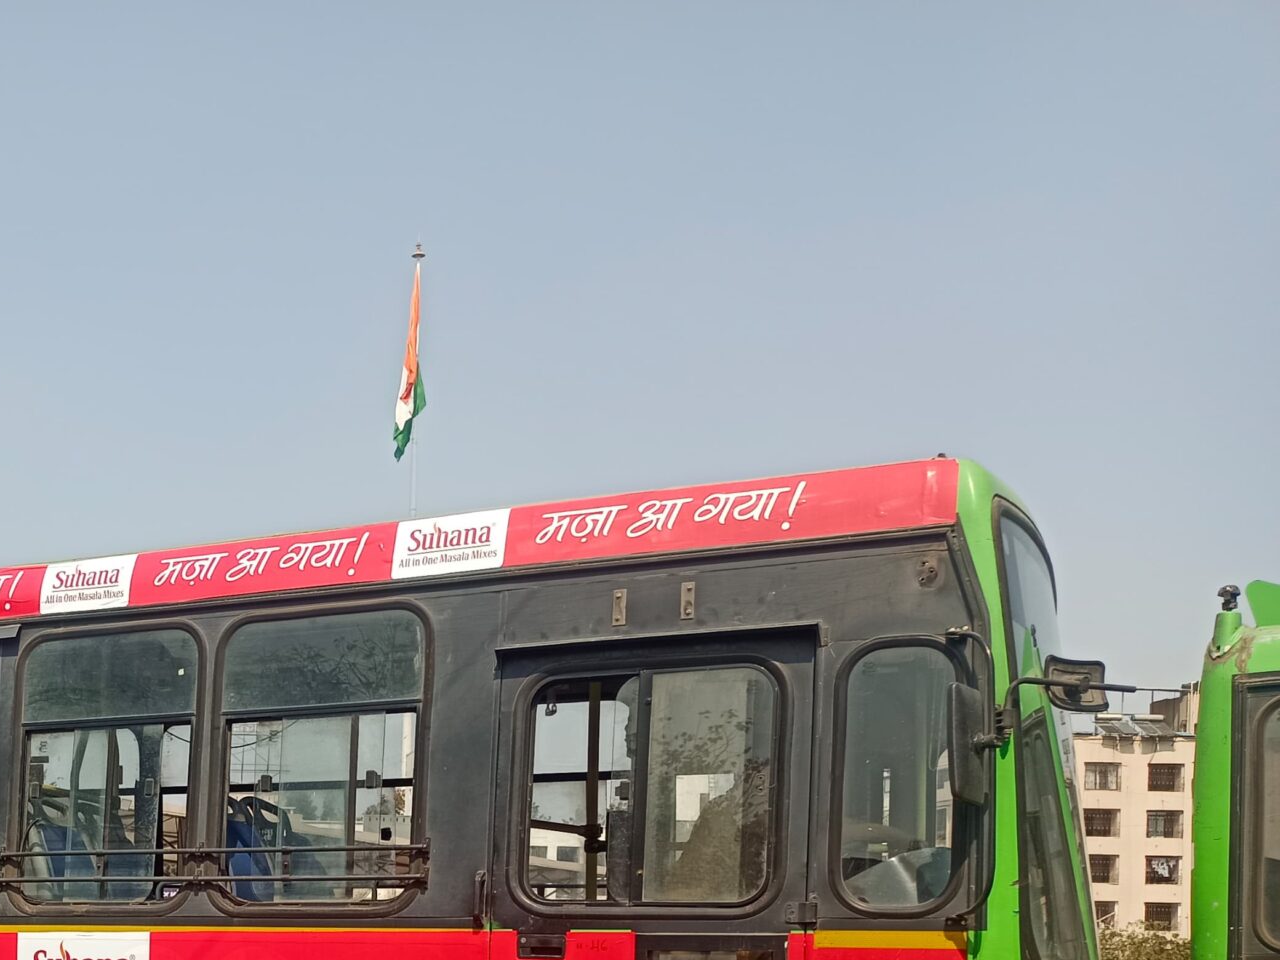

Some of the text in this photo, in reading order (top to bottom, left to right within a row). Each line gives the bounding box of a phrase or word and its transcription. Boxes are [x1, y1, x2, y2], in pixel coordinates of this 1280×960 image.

[535, 480, 807, 545] मज़ा आ गया!
[407, 525, 492, 552] Suhana
[153, 531, 370, 587] मज़ा आ गया!
[399, 549, 498, 569] All in One Masala Mixes
[52, 568, 120, 590] Suhana
